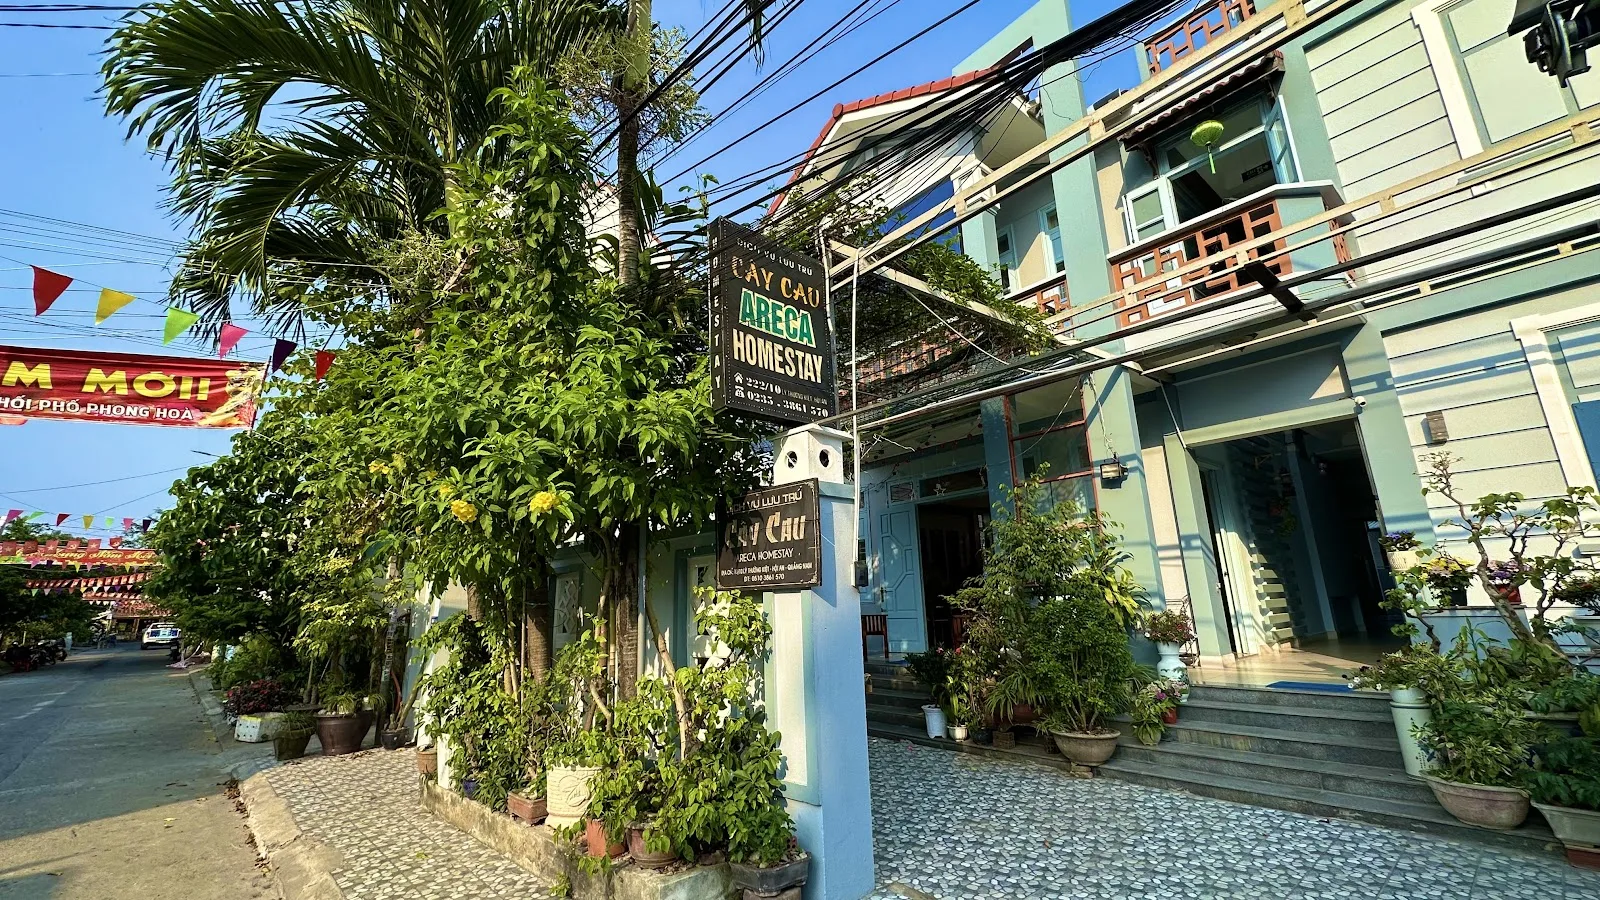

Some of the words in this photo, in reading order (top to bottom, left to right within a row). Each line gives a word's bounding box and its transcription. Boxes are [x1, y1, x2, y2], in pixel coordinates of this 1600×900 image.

[780, 276, 820, 308] CAU
[738, 287, 817, 348] ARECA
[732, 328, 823, 383] HOMESTAY
[746, 377, 782, 394] 222/10
[39, 399, 80, 413] PHỐ
[86, 403, 151, 417] PHONG
[747, 391, 774, 405] 0235
[810, 406, 829, 417] 570
[782, 485, 803, 503] TRÚ
[757, 548, 794, 560] HOMESTAY
